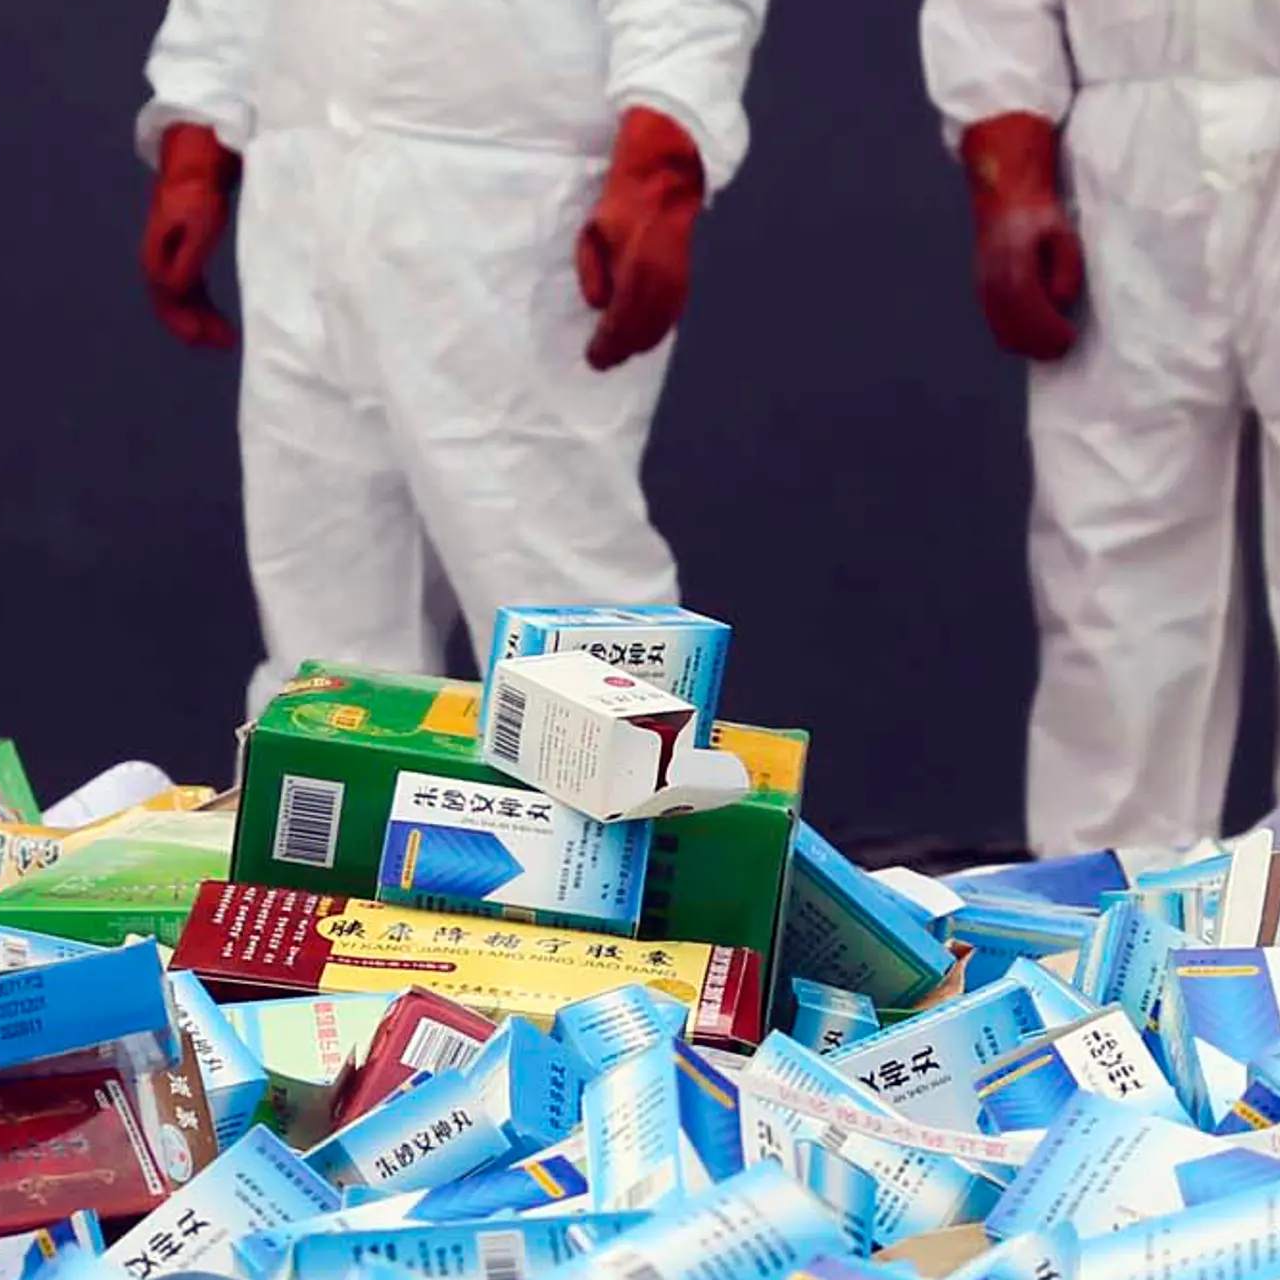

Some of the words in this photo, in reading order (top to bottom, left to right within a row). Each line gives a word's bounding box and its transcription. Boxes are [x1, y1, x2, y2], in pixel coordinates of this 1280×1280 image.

[580, 640, 666, 666] 砂安神丸
[413, 784, 554, 823] 朱砂安神丸
[373, 1108, 473, 1179] 朱砂安神丸
